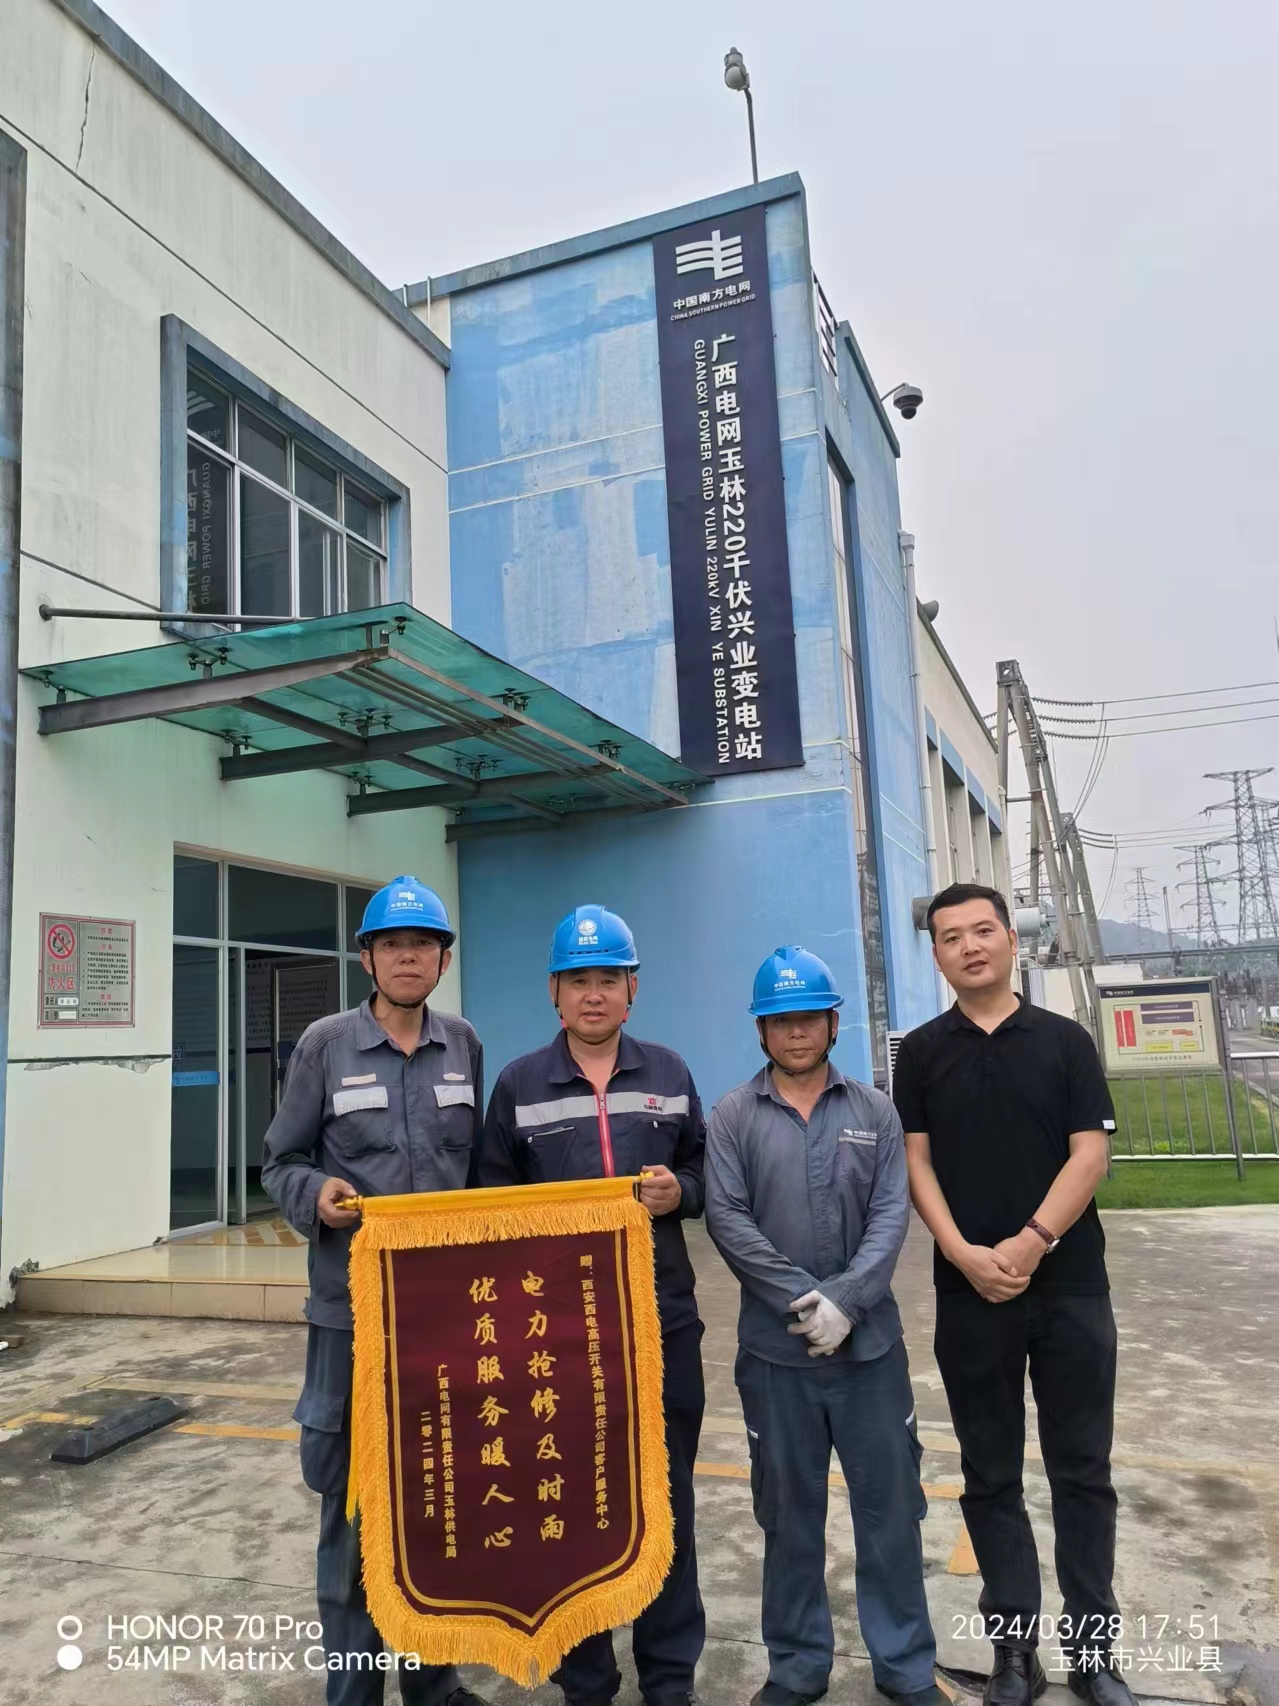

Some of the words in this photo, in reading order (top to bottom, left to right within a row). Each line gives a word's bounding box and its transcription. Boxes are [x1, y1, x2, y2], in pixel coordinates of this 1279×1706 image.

[670, 312, 688, 321] CHINA
[688, 303, 719, 316] SOUTHERN
[719, 298, 741, 309] POWER
[741, 293, 756, 303] GRID
[673, 280, 750, 310] 中国南方电网
[694, 339, 709, 405] GUANGXI
[698, 409, 712, 461] POWER
[701, 466, 715, 501] GRID
[704, 506, 717, 551] YULIN
[711, 333, 763, 760] 广西电网玉林220千伏兴业变电站
[709, 604, 722, 632] XIN
[712, 641, 724, 661] YE
[713, 667, 730, 764] SUBSTATION
[469, 1276, 515, 1549] 优质服务暖人心
[521, 1270, 565, 1541] 电力抢修及时雨
[420, 1411, 435, 1518] 二零二四年三月
